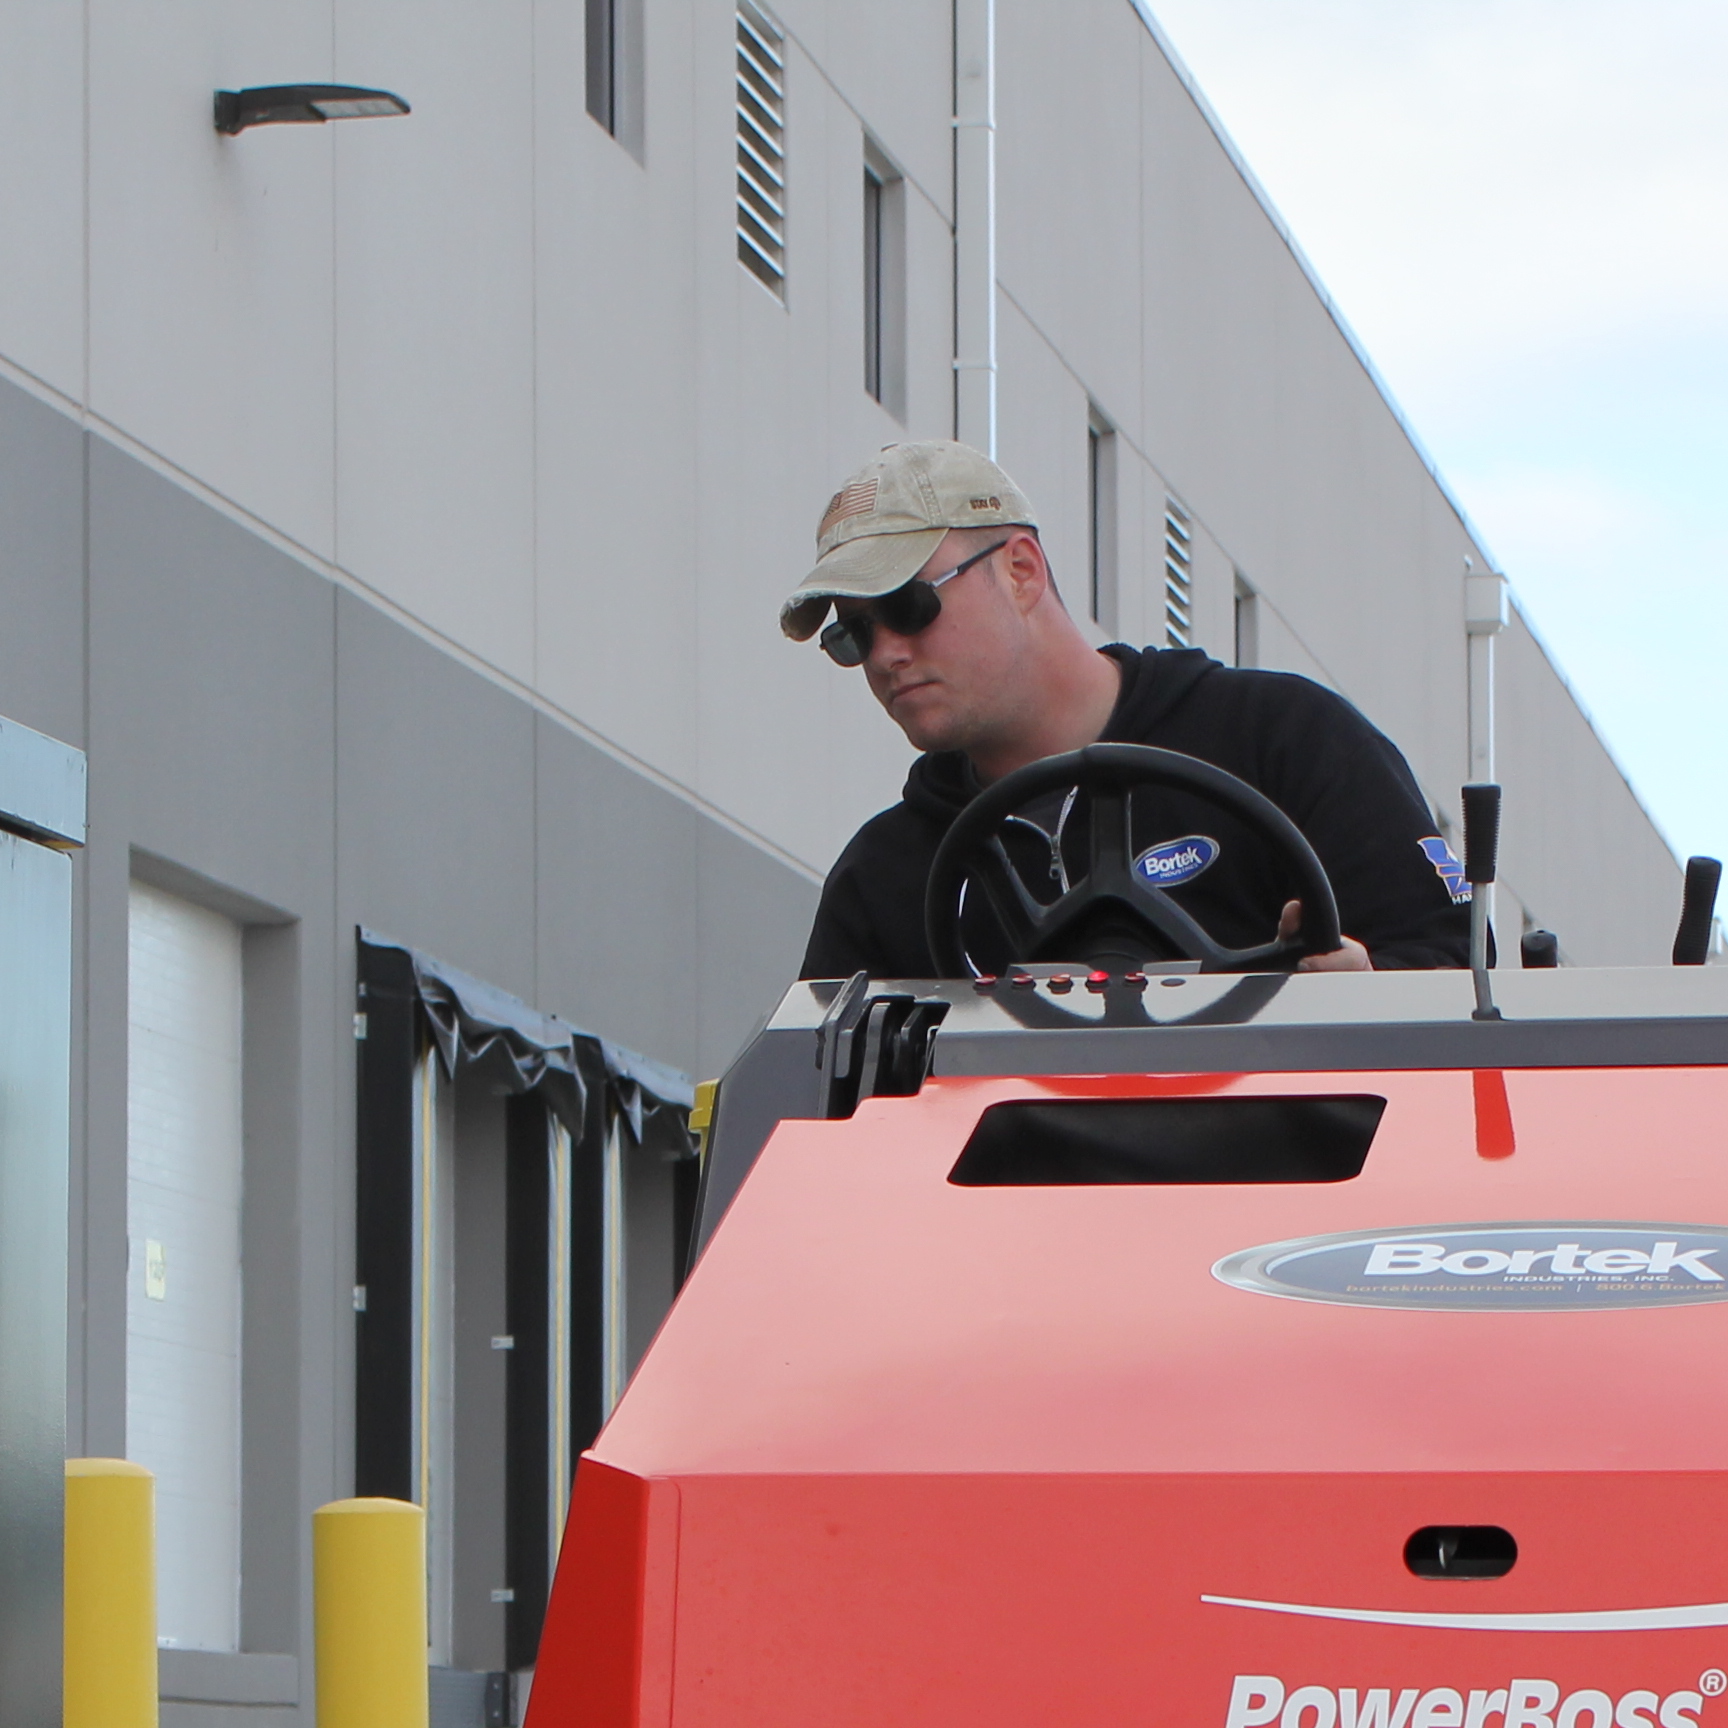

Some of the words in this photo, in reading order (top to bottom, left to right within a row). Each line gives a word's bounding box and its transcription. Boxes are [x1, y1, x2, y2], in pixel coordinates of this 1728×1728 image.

[1145, 846, 1203, 876] Bortek
[1363, 1242, 1726, 1282] Bortek
[1346, 1283, 1564, 1293] bortekindustries.com
[1634, 1275, 1675, 1283] INC.
